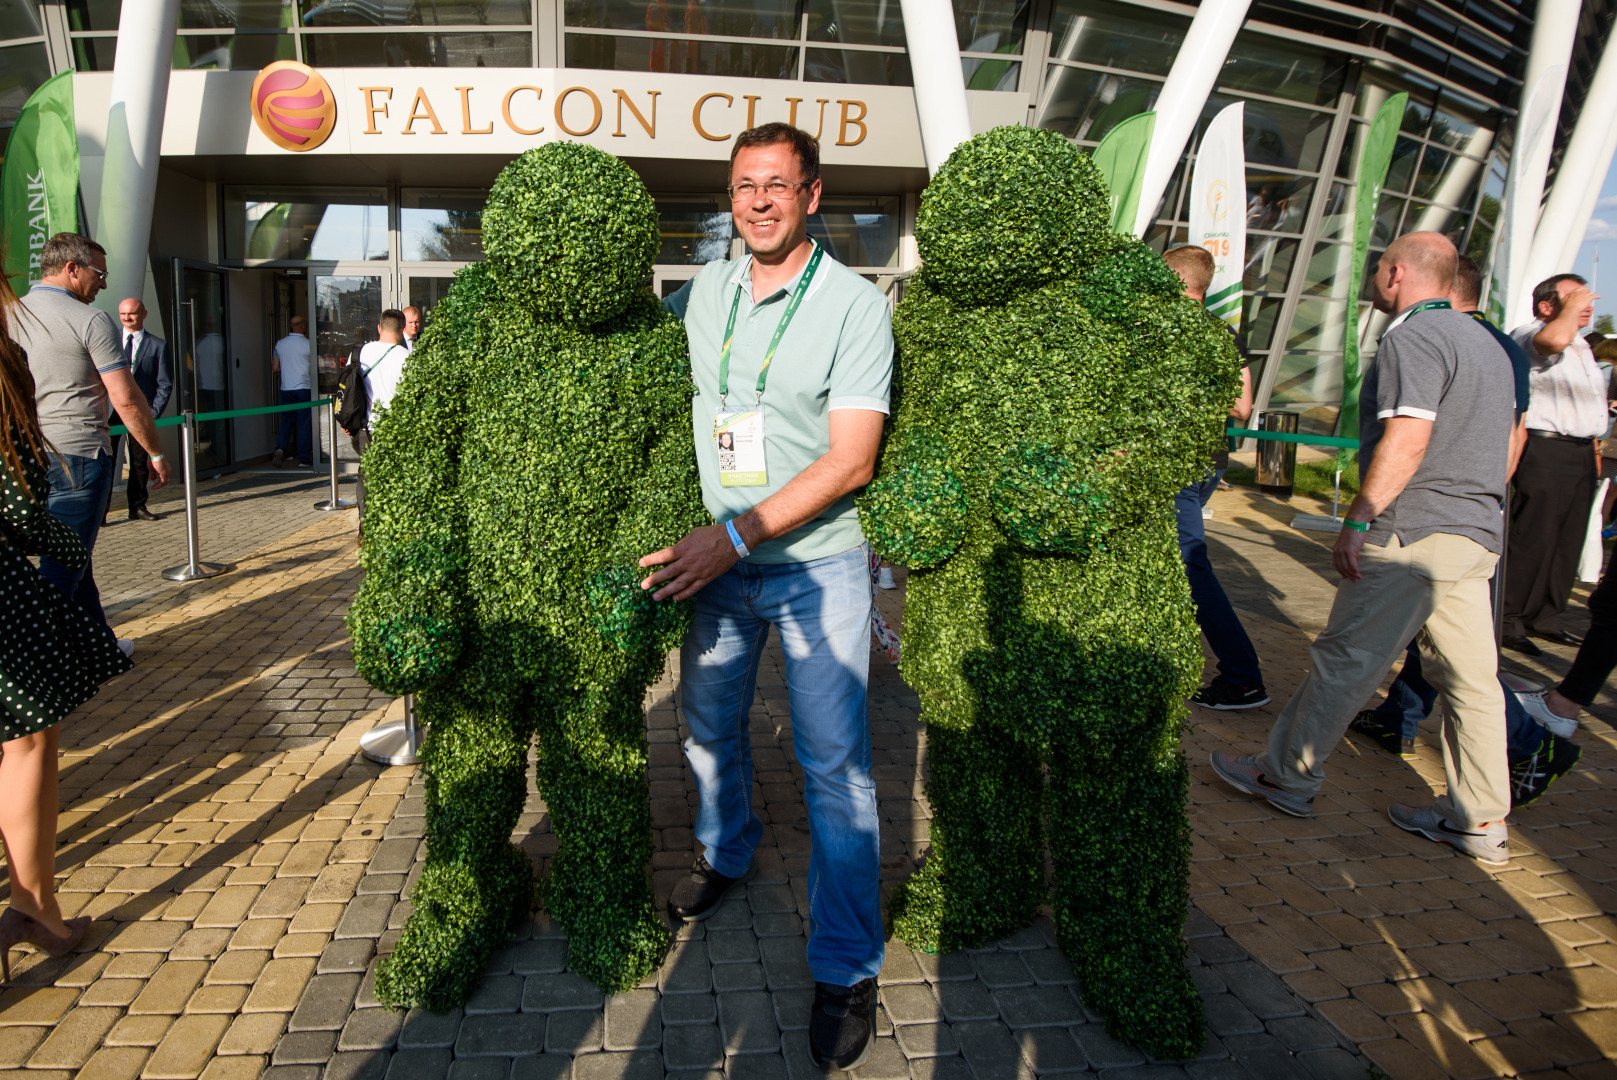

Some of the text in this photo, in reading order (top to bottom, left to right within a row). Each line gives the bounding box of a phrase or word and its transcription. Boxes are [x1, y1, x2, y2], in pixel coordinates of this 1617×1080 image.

[358, 85, 868, 146] FALCON CLUB
[26, 168, 46, 286] ERBANK
